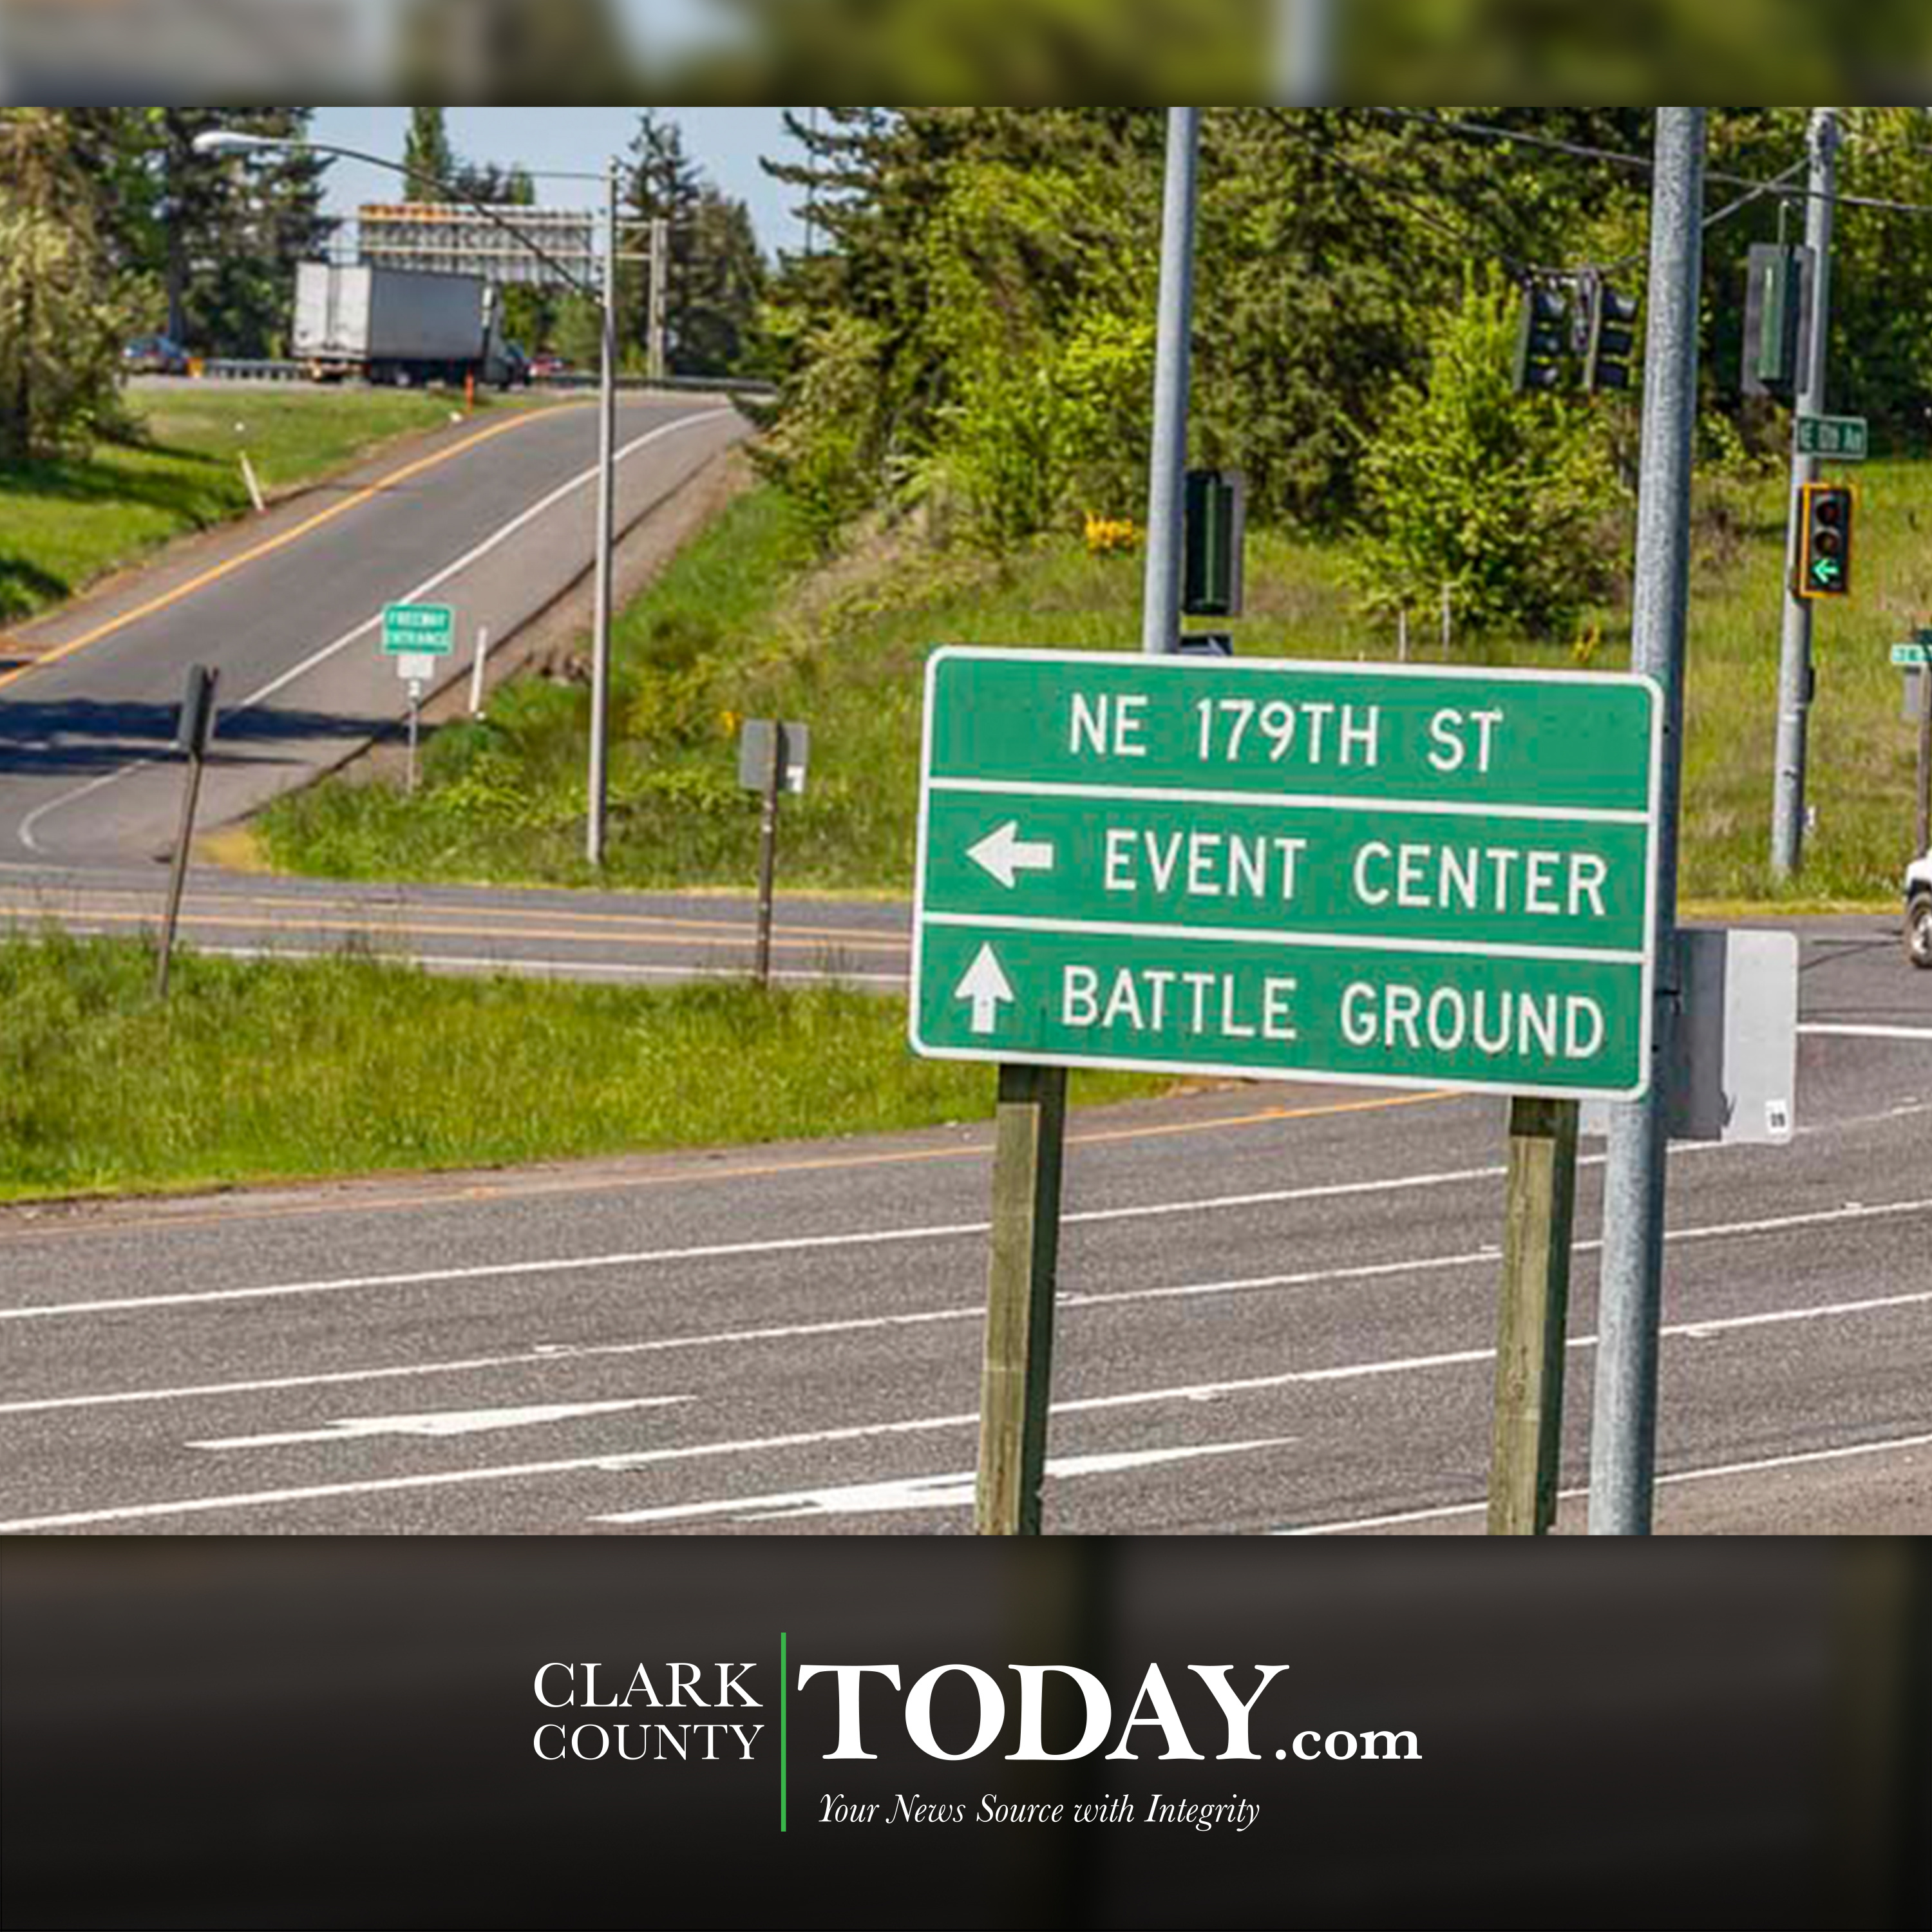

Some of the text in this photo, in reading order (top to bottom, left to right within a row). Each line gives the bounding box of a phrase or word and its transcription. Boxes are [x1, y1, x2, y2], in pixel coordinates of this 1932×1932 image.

[1070, 692, 1504, 773] NE 179TH ST
[1104, 828, 1608, 917] EVENT CENTER
[1061, 964, 1604, 1059] BATTLE GROUND
